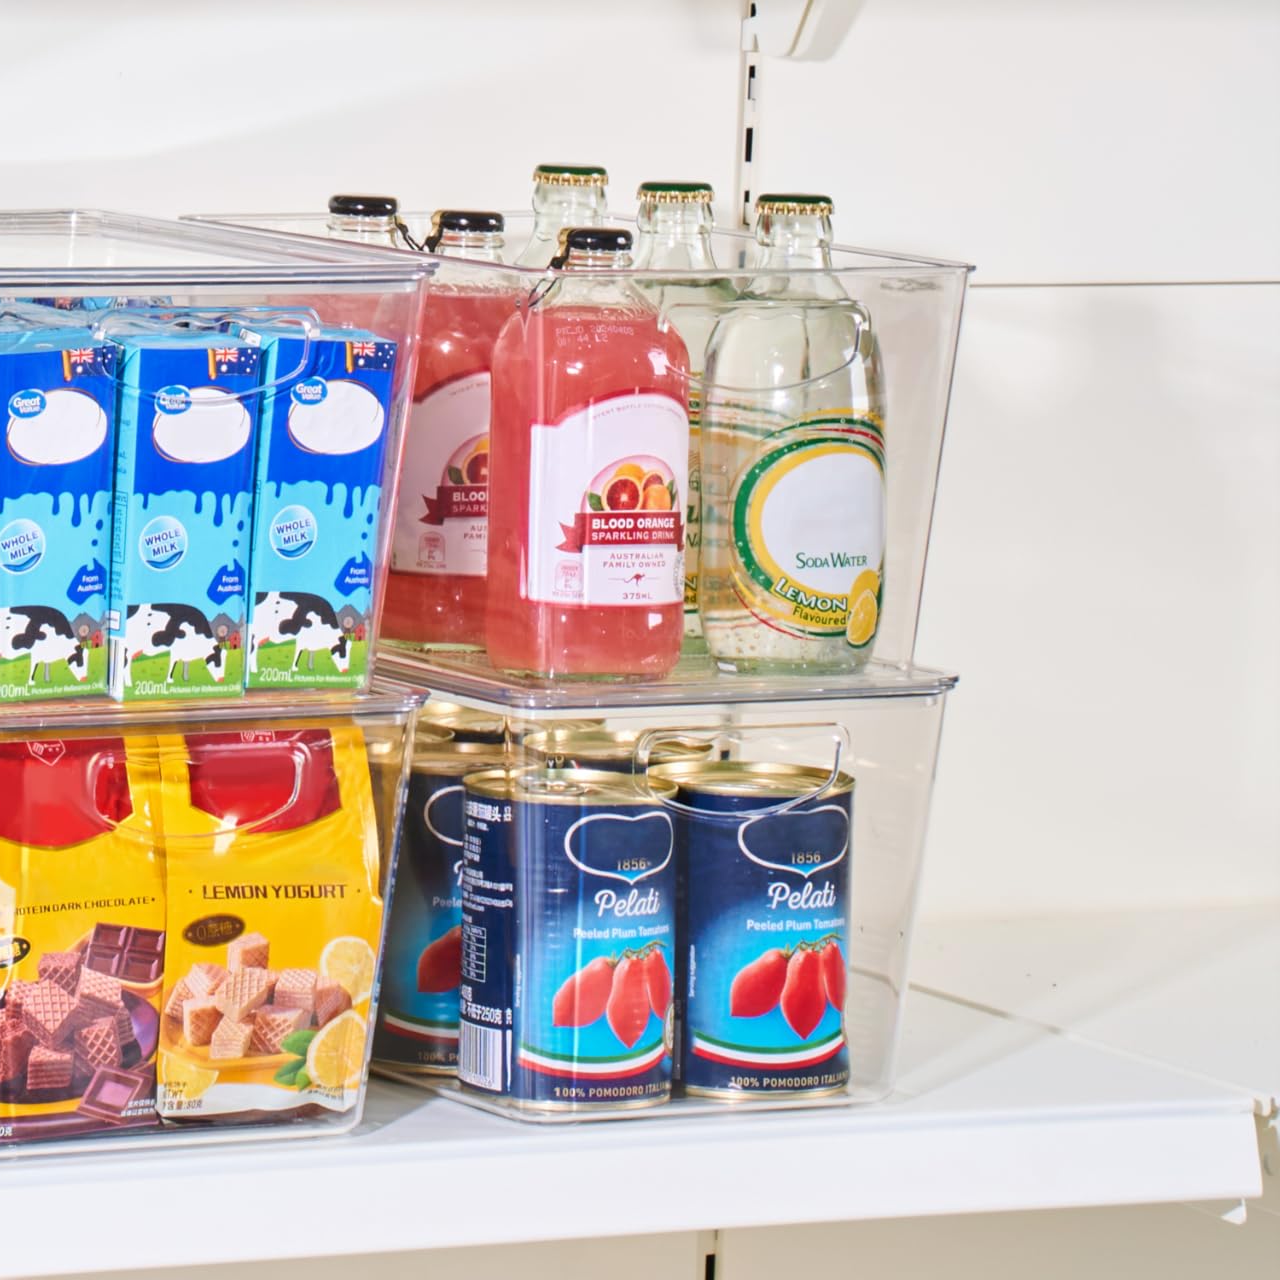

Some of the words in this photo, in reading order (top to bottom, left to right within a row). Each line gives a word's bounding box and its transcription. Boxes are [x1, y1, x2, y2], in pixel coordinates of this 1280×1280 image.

[296, 384, 322, 394] Great
[13, 396, 41, 407] Great
[453, 491, 488, 503] BLOO
[452, 504, 487, 513] SPARK
[276, 519, 311, 535] WHOLE
[592, 518, 634, 529] BLOOD
[637, 518, 675, 529] ORANGE
[1, 531, 39, 551] WHOLE
[145, 528, 181, 546] WHOLE
[283, 532, 307, 545] MILK
[592, 531, 649, 541] SPARKLING
[652, 531, 675, 539] DRINK
[10, 544, 35, 560] MILK
[152, 542, 177, 557] MILK
[610, 552, 664, 560] AUSTRALIAN
[350, 567, 366, 575] From
[603, 561, 635, 569] FAMILY
[82, 575, 99, 583] From
[775, 577, 848, 612] LEMON
[793, 606, 846, 625] Flavoured
[260, 668, 293, 682] 200mL
[134, 681, 169, 695] 200mL
[791, 851, 821, 864] 1856
[617, 858, 646, 871] 1856
[202, 885, 268, 899] LEMON
[271, 884, 347, 899] YOGURT
[768, 881, 836, 910] Pelati
[53, 902, 82, 913] DARK
[84, 896, 149, 910] CHOCOLATE
[432, 896, 462, 908] Peele
[594, 888, 660, 917] Pelati
[746, 919, 784, 931] Peeled
[786, 919, 812, 931] Plum
[573, 927, 610, 939] Peeled
[612, 927, 637, 938] Plum
[730, 1076, 760, 1088] 100%
[763, 1076, 819, 1088] POMODORO
[553, 1087, 586, 1098] 100%
[589, 1086, 644, 1098] POMODORO
